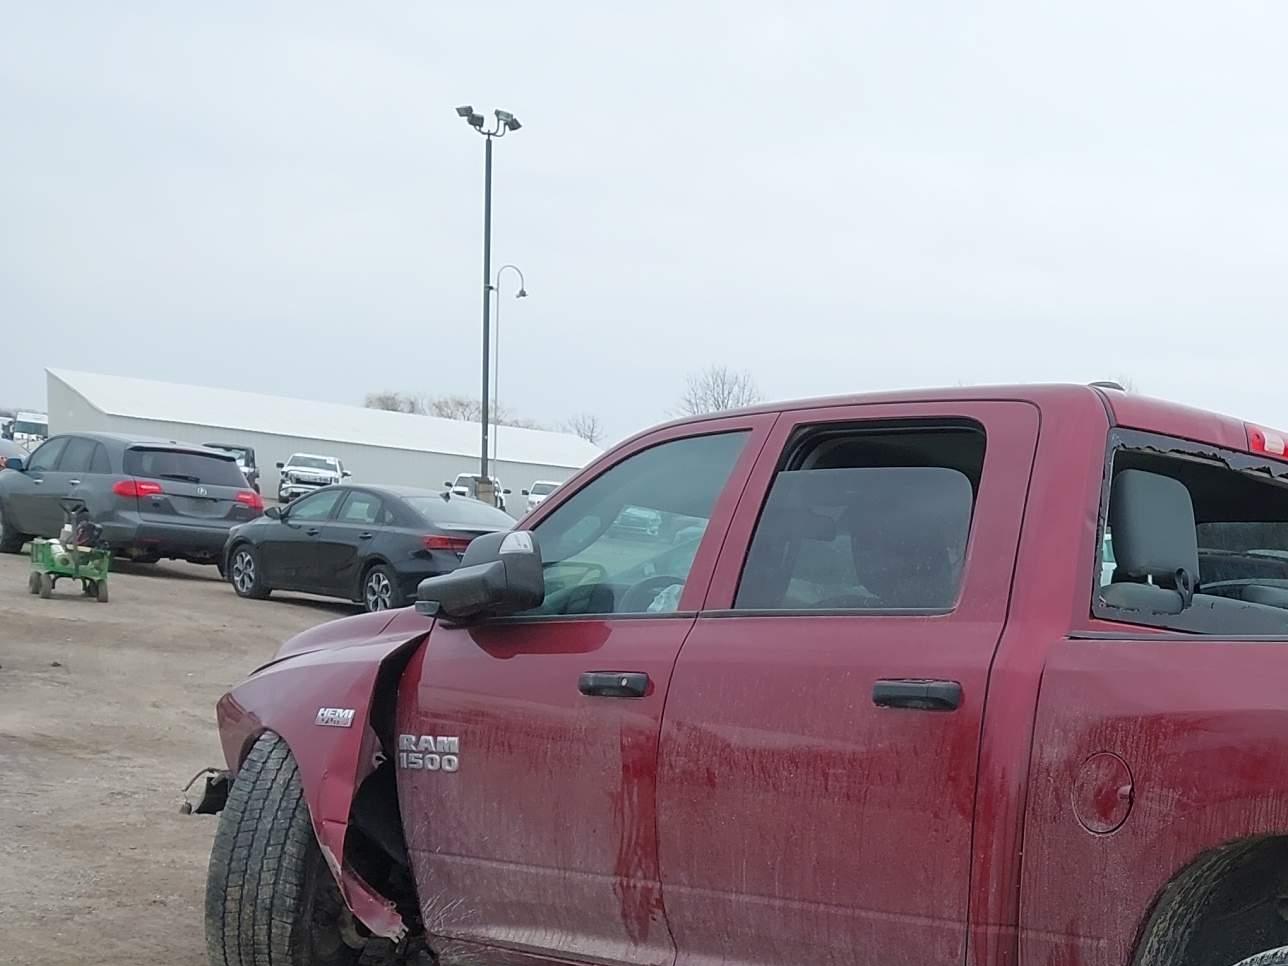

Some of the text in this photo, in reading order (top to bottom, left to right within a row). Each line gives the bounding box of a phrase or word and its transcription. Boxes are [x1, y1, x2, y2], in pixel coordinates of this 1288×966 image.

[318, 707, 355, 719] HEMI
[399, 734, 459, 753] RAM
[400, 752, 459, 772] 1500
